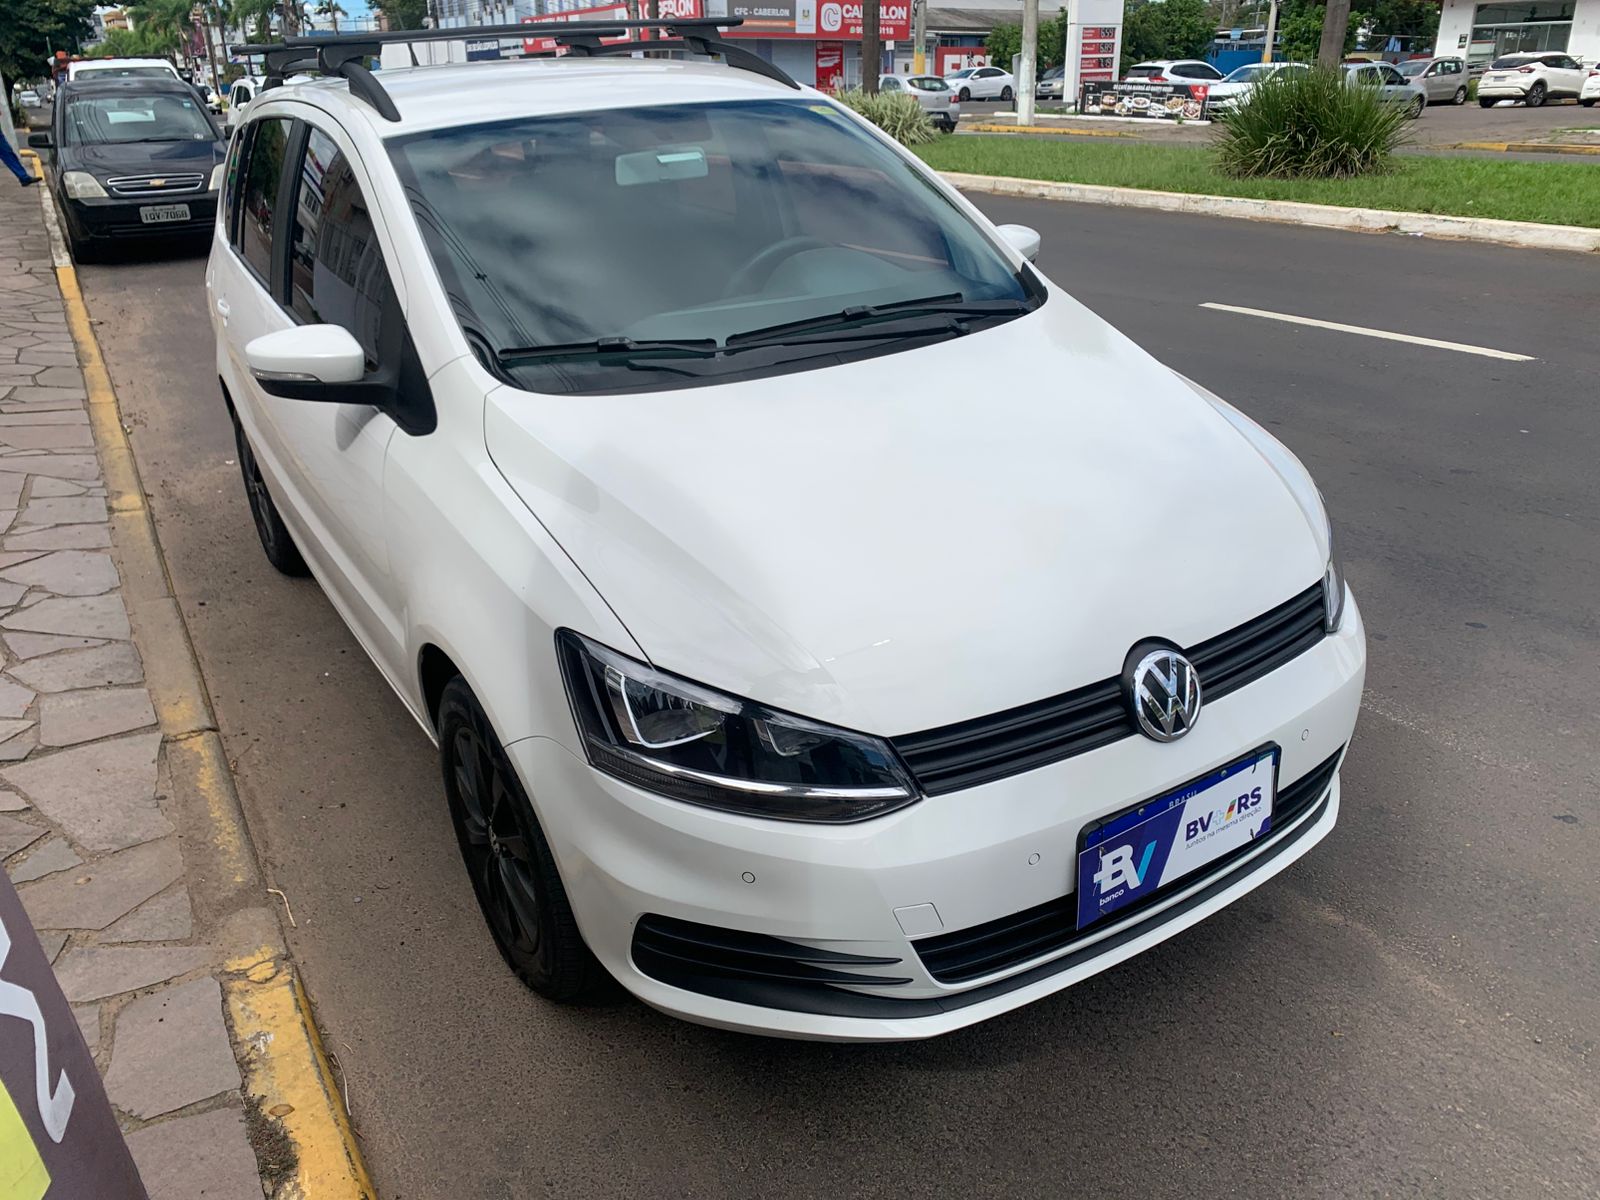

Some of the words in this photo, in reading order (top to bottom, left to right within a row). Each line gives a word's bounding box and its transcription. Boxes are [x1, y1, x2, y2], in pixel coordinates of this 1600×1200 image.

[734, 7, 748, 16] CFC
[753, 8, 790, 17] CABERLON
[1207, 831, 1215, 840] na
[1216, 819, 1239, 835] mesma
[1099, 889, 1125, 906] banco
